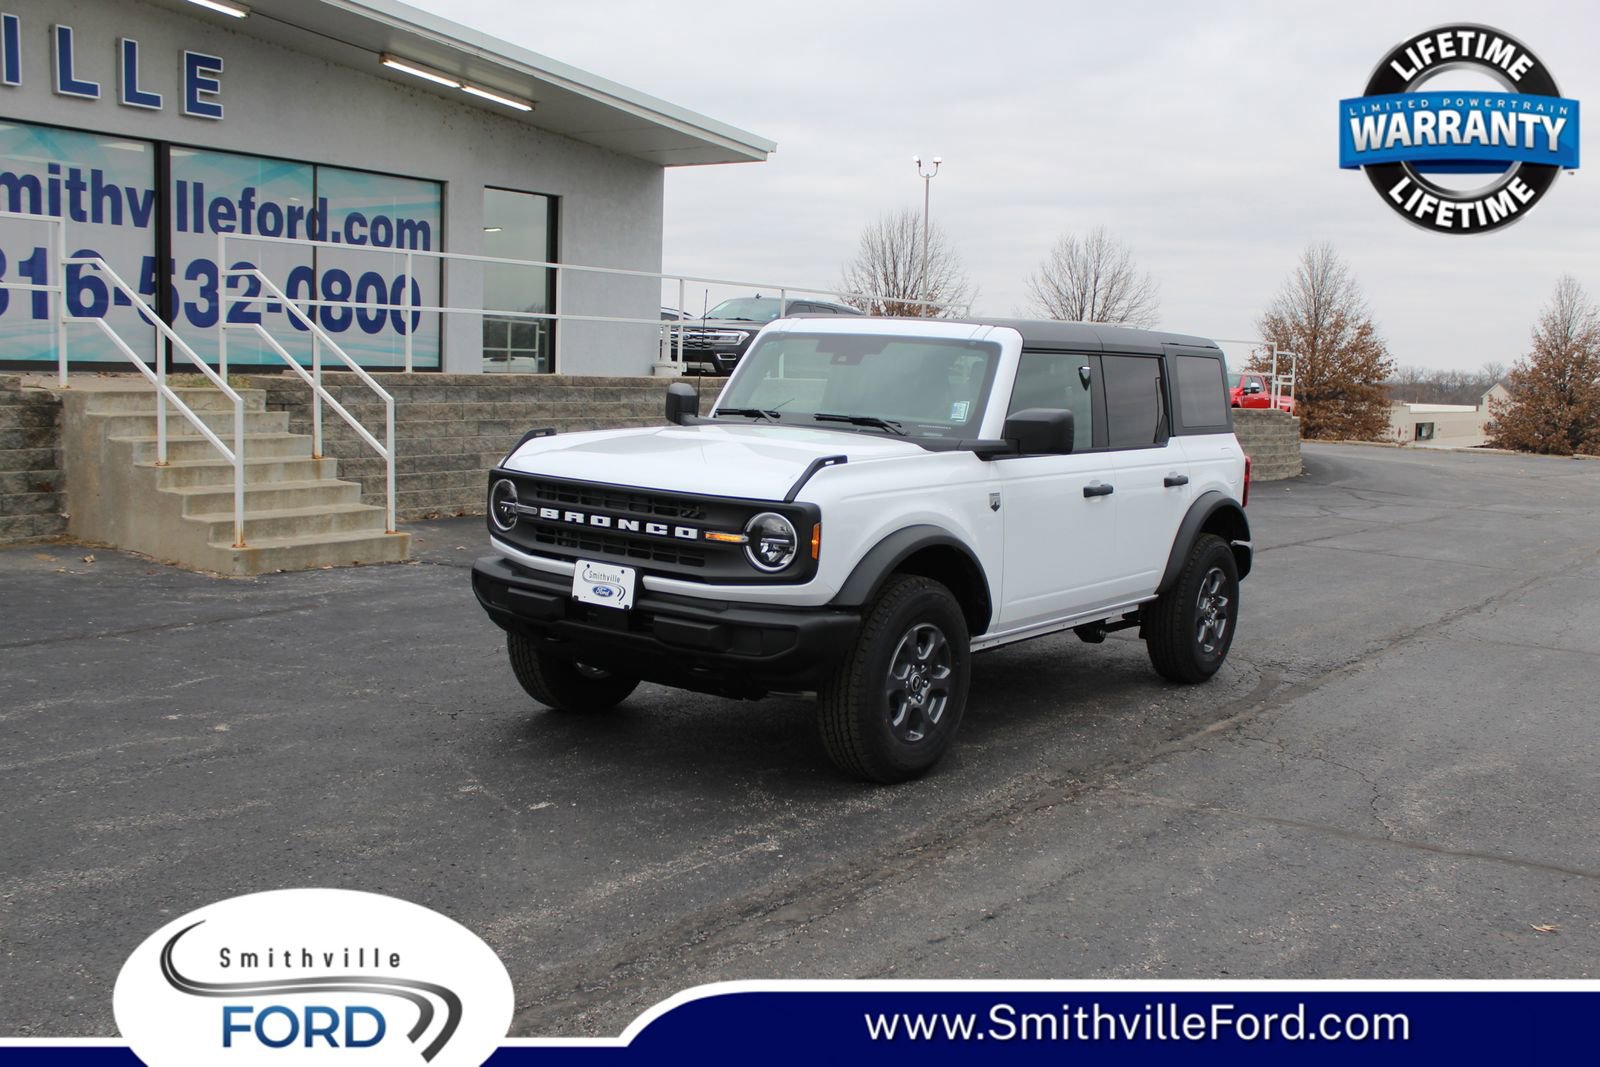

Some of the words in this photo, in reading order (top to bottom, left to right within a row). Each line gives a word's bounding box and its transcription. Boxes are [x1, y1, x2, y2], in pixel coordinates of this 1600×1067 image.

[0, 162, 431, 251] mithvlleford.com
[0, 247, 421, 336] 16-532-0800
[540, 507, 698, 540] BRONCO
[589, 570, 621, 583] Smithville
